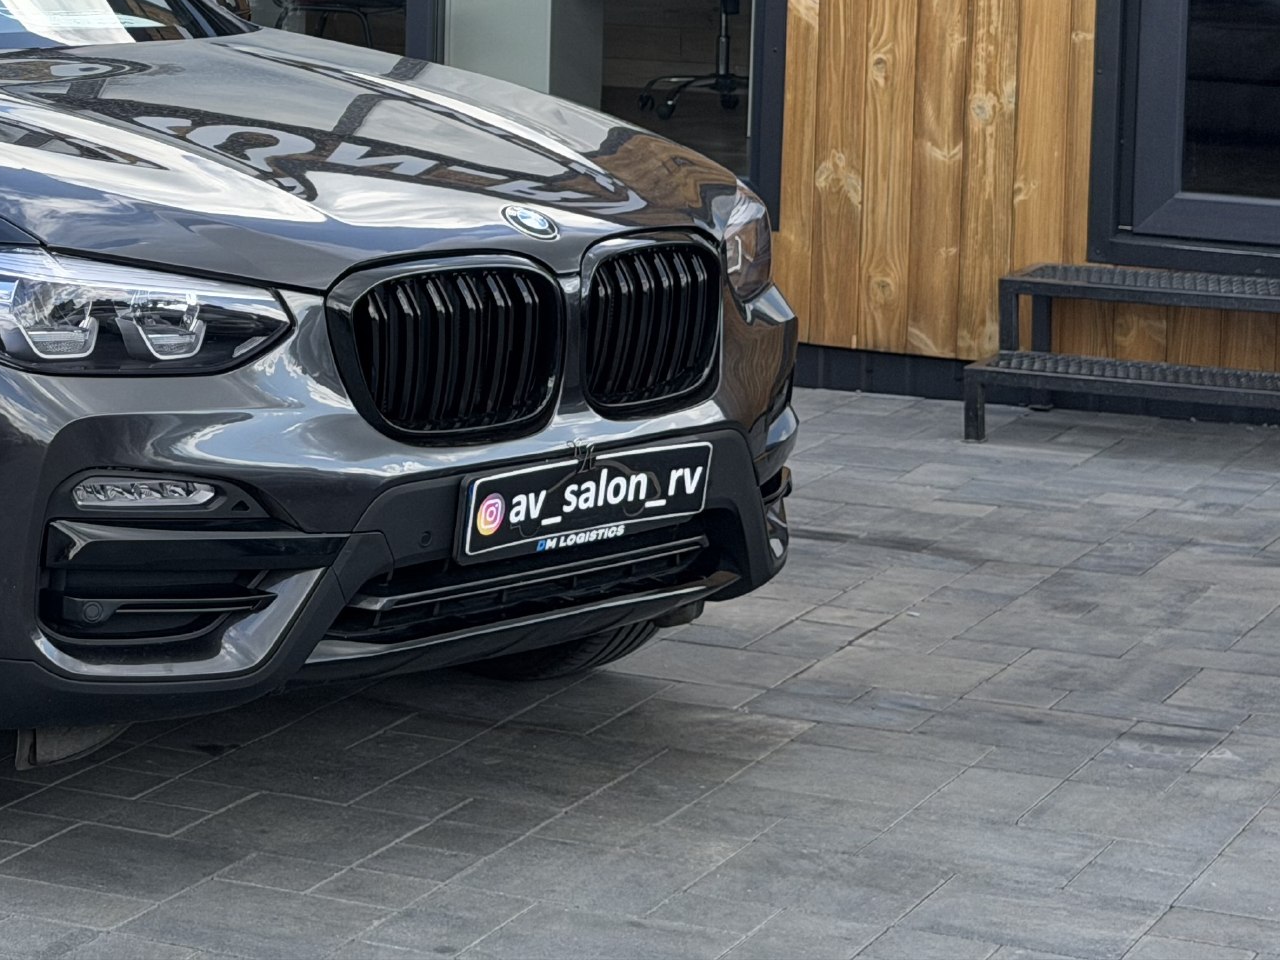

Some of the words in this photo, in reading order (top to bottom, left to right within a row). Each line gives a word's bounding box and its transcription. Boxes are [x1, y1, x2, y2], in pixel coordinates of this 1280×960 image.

[509, 466, 703, 525] av_salon_rv
[536, 538, 557, 552] DM
[559, 525, 625, 547] LOGISTICS
